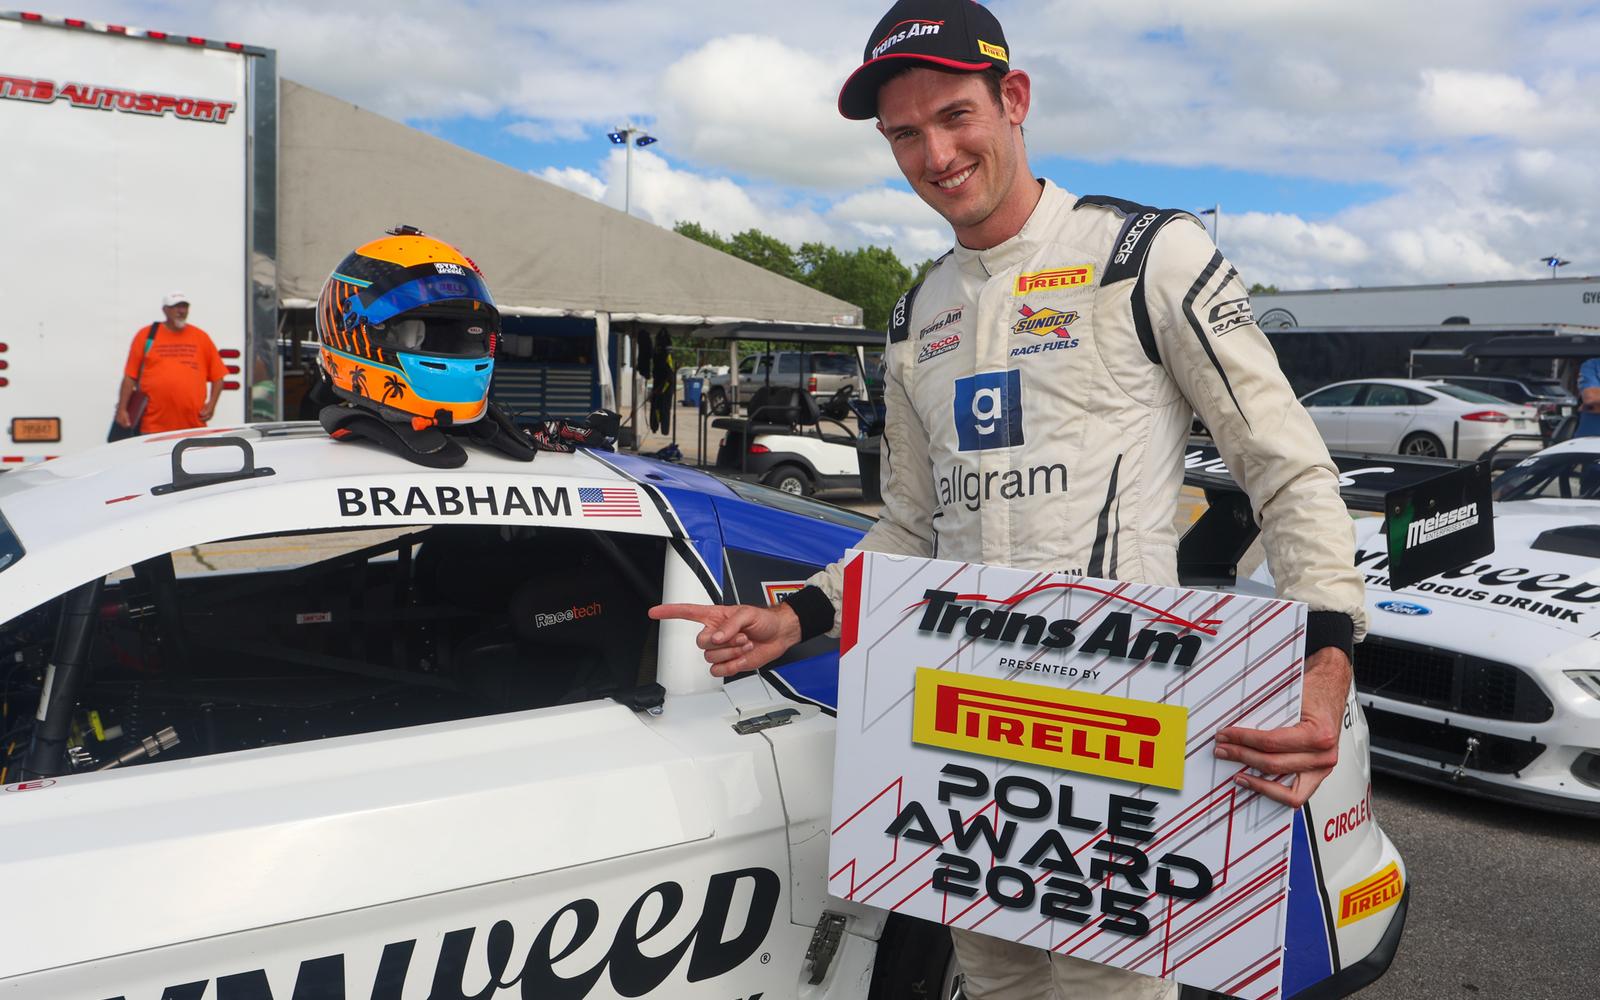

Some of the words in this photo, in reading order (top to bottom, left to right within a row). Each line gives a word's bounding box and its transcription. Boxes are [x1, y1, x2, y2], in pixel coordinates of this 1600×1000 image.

[872, 30, 906, 59] Trans
[907, 23, 940, 38] Am
[59, 83, 236, 122] AUTOSPORT
[1114, 212, 1156, 264] sparco
[1019, 267, 1088, 292] PIRELLI
[944, 310, 962, 326] Am
[1017, 311, 1074, 333] SUNOCO
[931, 335, 960, 351] SCCA
[1010, 344, 1040, 357] RACE
[1043, 338, 1079, 353] FUELS
[337, 486, 572, 517] BRABHAM
[940, 462, 1068, 512] allgram
[1406, 502, 1477, 550] Meissen
[535, 602, 602, 628] Racetech
[1383, 601, 1422, 616] Ford
[1491, 593, 1584, 624] DRINK
[918, 589, 1081, 649] Trans
[1079, 611, 1202, 667] Am
[1000, 657, 1078, 678] PRESENTED
[1082, 669, 1101, 680] BY
[935, 684, 1161, 769] PIRELLI
[938, 763, 1159, 842] POLE
[1324, 798, 1366, 843] CIRCLE
[884, 800, 1213, 901] AWARD
[932, 852, 1151, 937] 2025
[1341, 869, 1401, 920] PIRELLI
